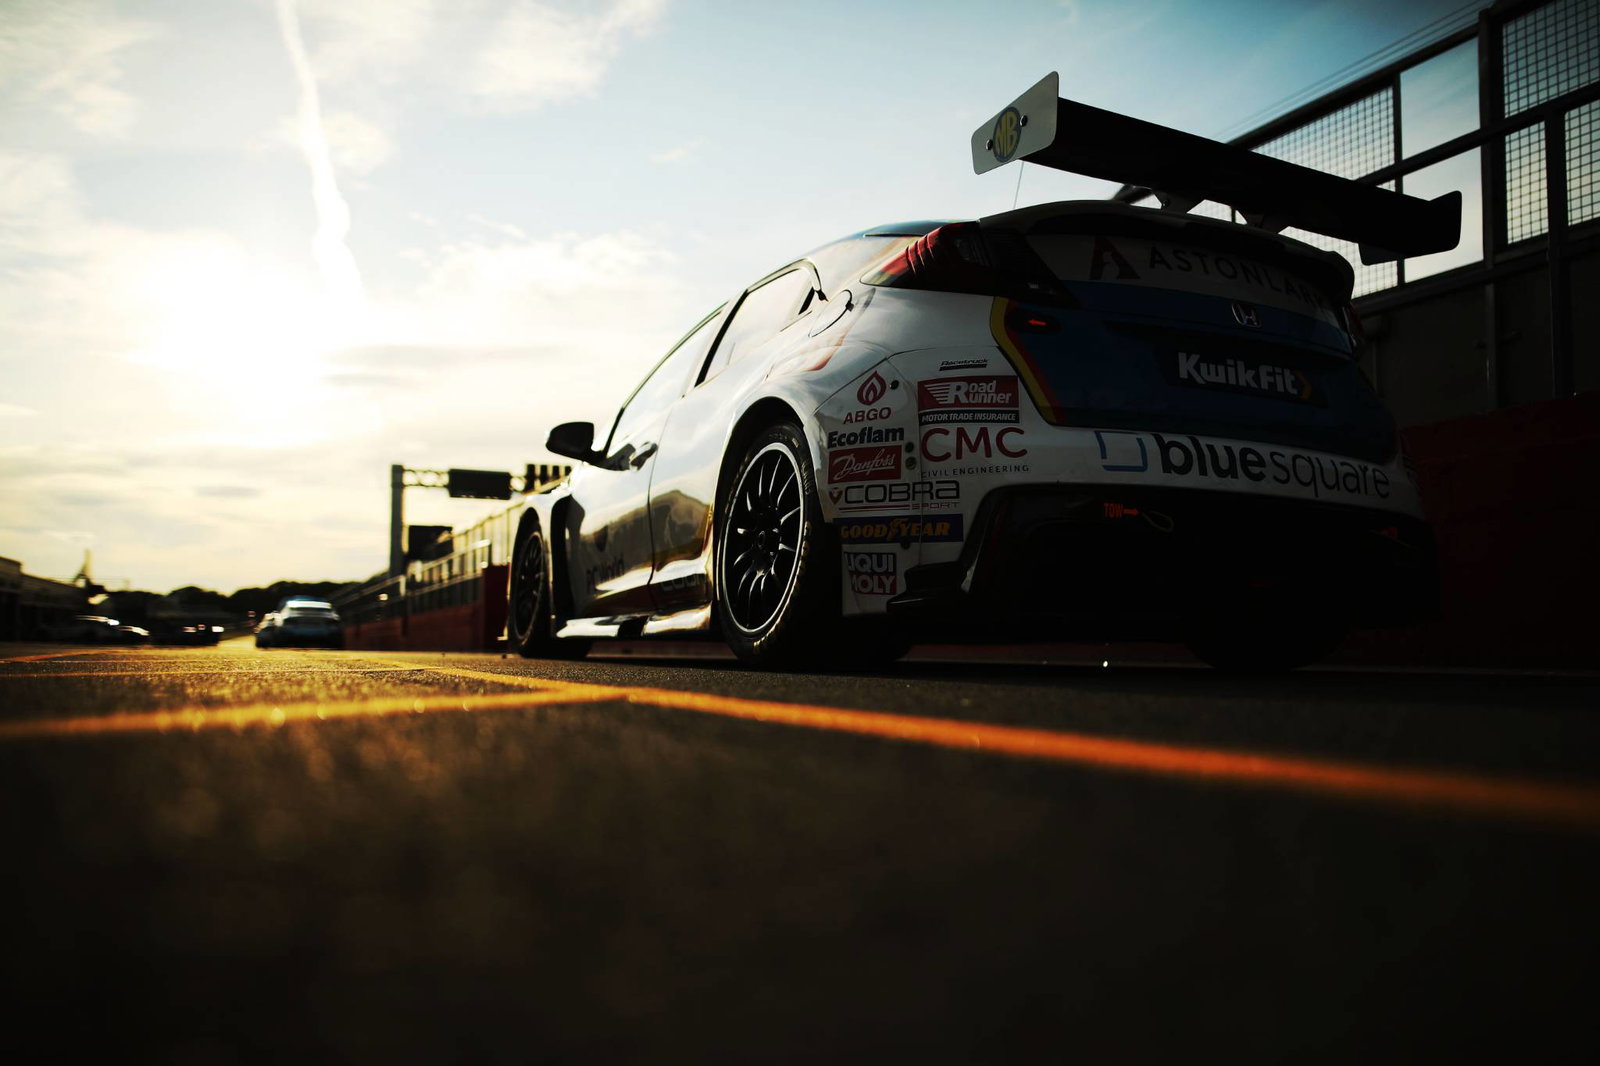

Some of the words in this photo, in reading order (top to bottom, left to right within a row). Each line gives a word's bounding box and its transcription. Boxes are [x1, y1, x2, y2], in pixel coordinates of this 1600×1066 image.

[843, 407, 892, 424] ABGO
[921, 414, 949, 423] MOTOR
[950, 413, 974, 422] TRADE
[974, 413, 1017, 422] INSURANCE
[827, 427, 905, 449] Ecoflam
[921, 427, 1028, 462] CMC
[832, 448, 897, 480] Danfoss
[921, 469, 949, 479] CIVIL
[952, 465, 1030, 476] ENGINEERING
[911, 502, 961, 510] SPORT
[1104, 502, 1124, 520] TOW
[840, 518, 951, 540] GOODYEAR
[845, 552, 895, 573] IQUI
